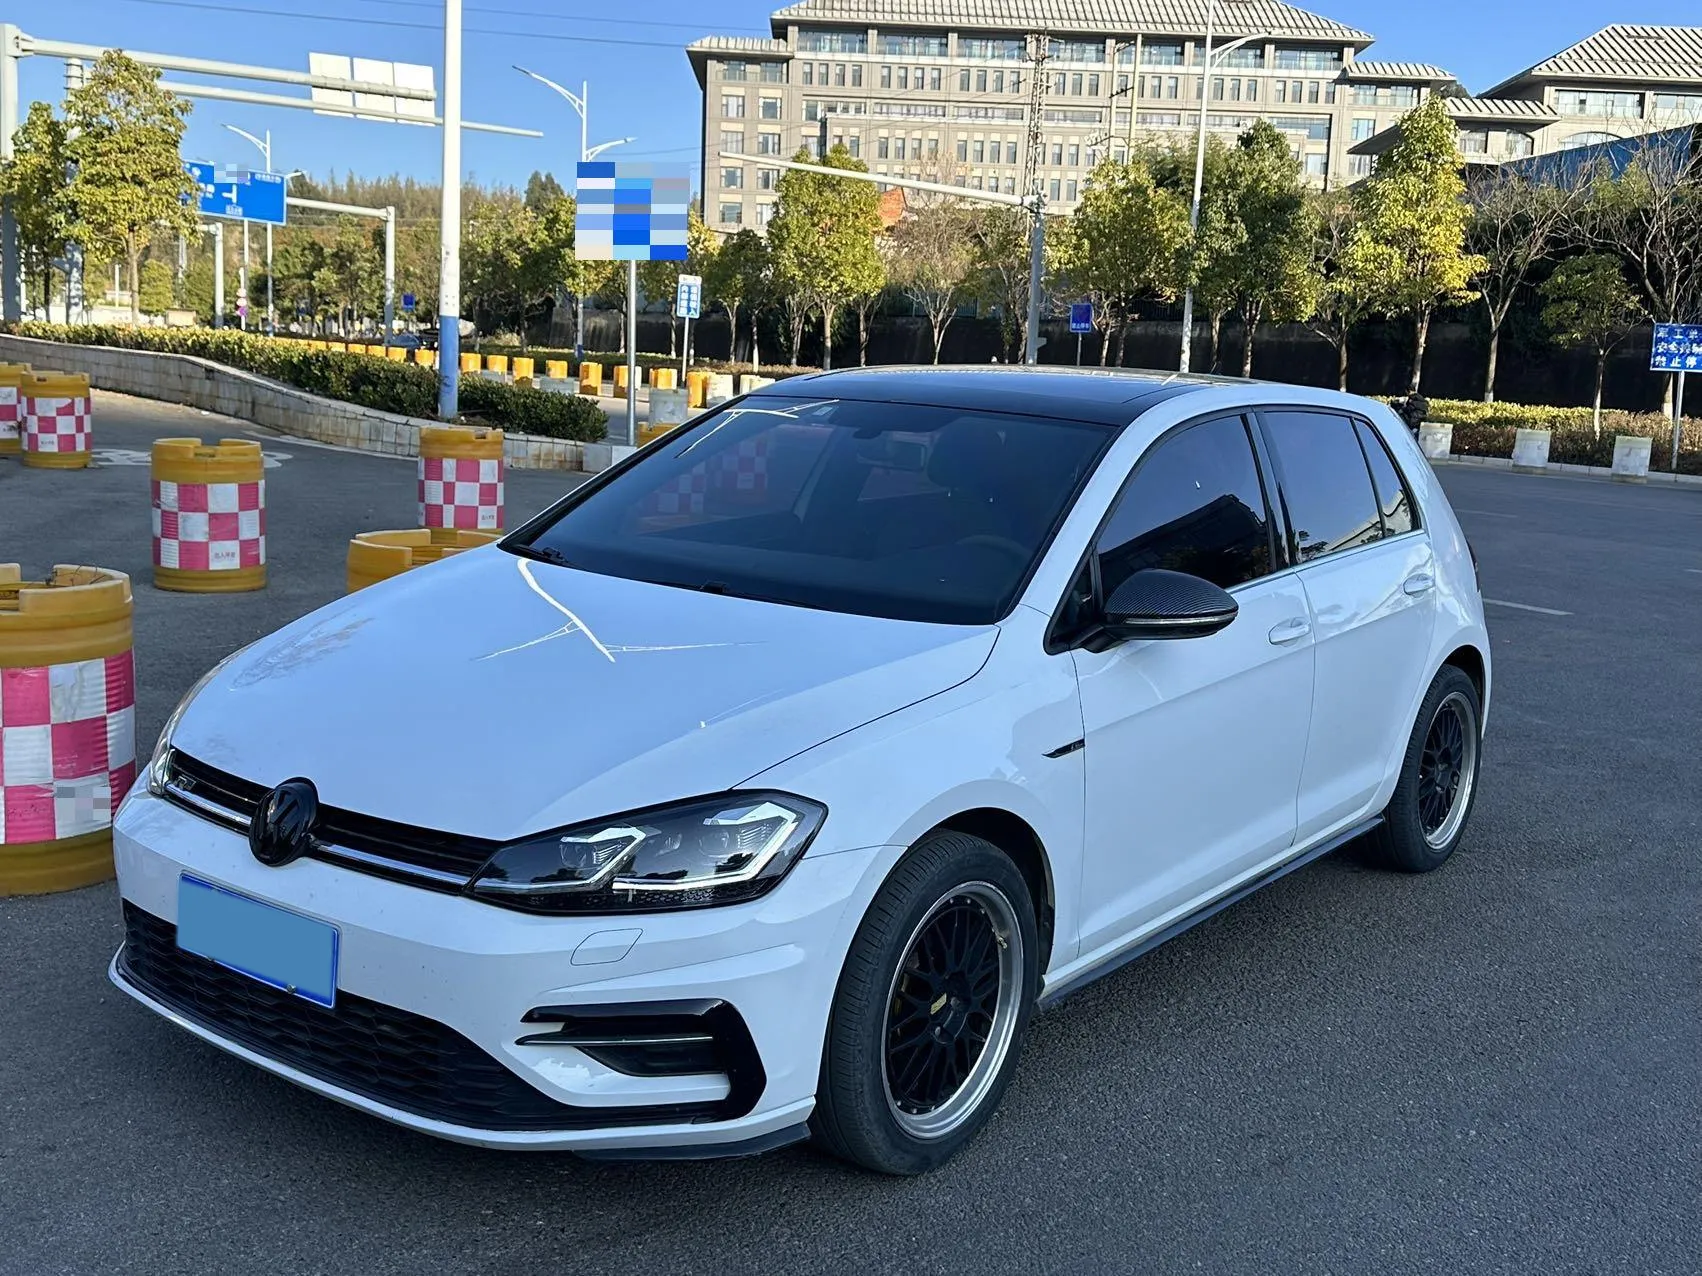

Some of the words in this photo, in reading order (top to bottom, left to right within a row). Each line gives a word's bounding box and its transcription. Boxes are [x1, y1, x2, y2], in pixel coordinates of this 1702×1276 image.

[1657, 327, 1702, 340] 军工单
[1655, 355, 1702, 369] 禁止停
